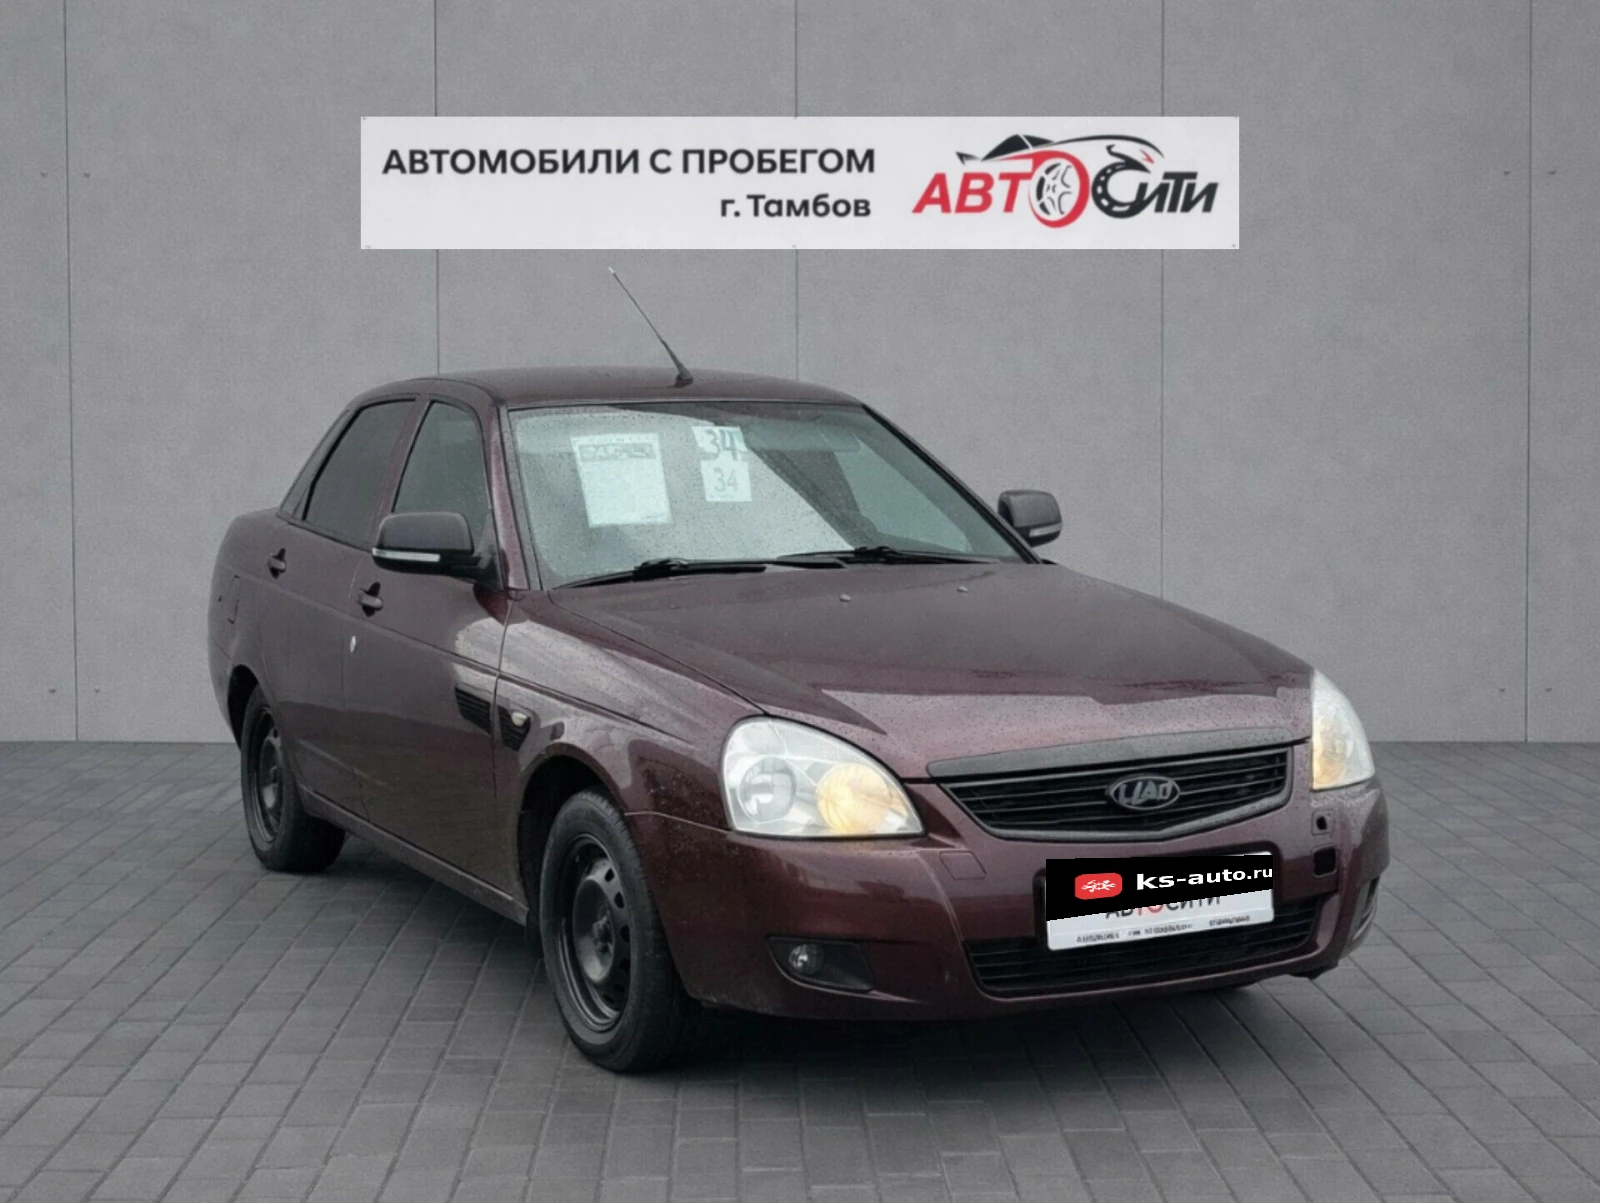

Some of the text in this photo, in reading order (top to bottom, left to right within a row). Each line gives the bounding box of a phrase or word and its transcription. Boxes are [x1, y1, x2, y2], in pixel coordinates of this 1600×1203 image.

[382, 149, 876, 174] АВТОМОБИЛИ С ПРОБЕГОМ
[720, 194, 872, 218] г. Тамбов
[713, 467, 740, 492] 34
